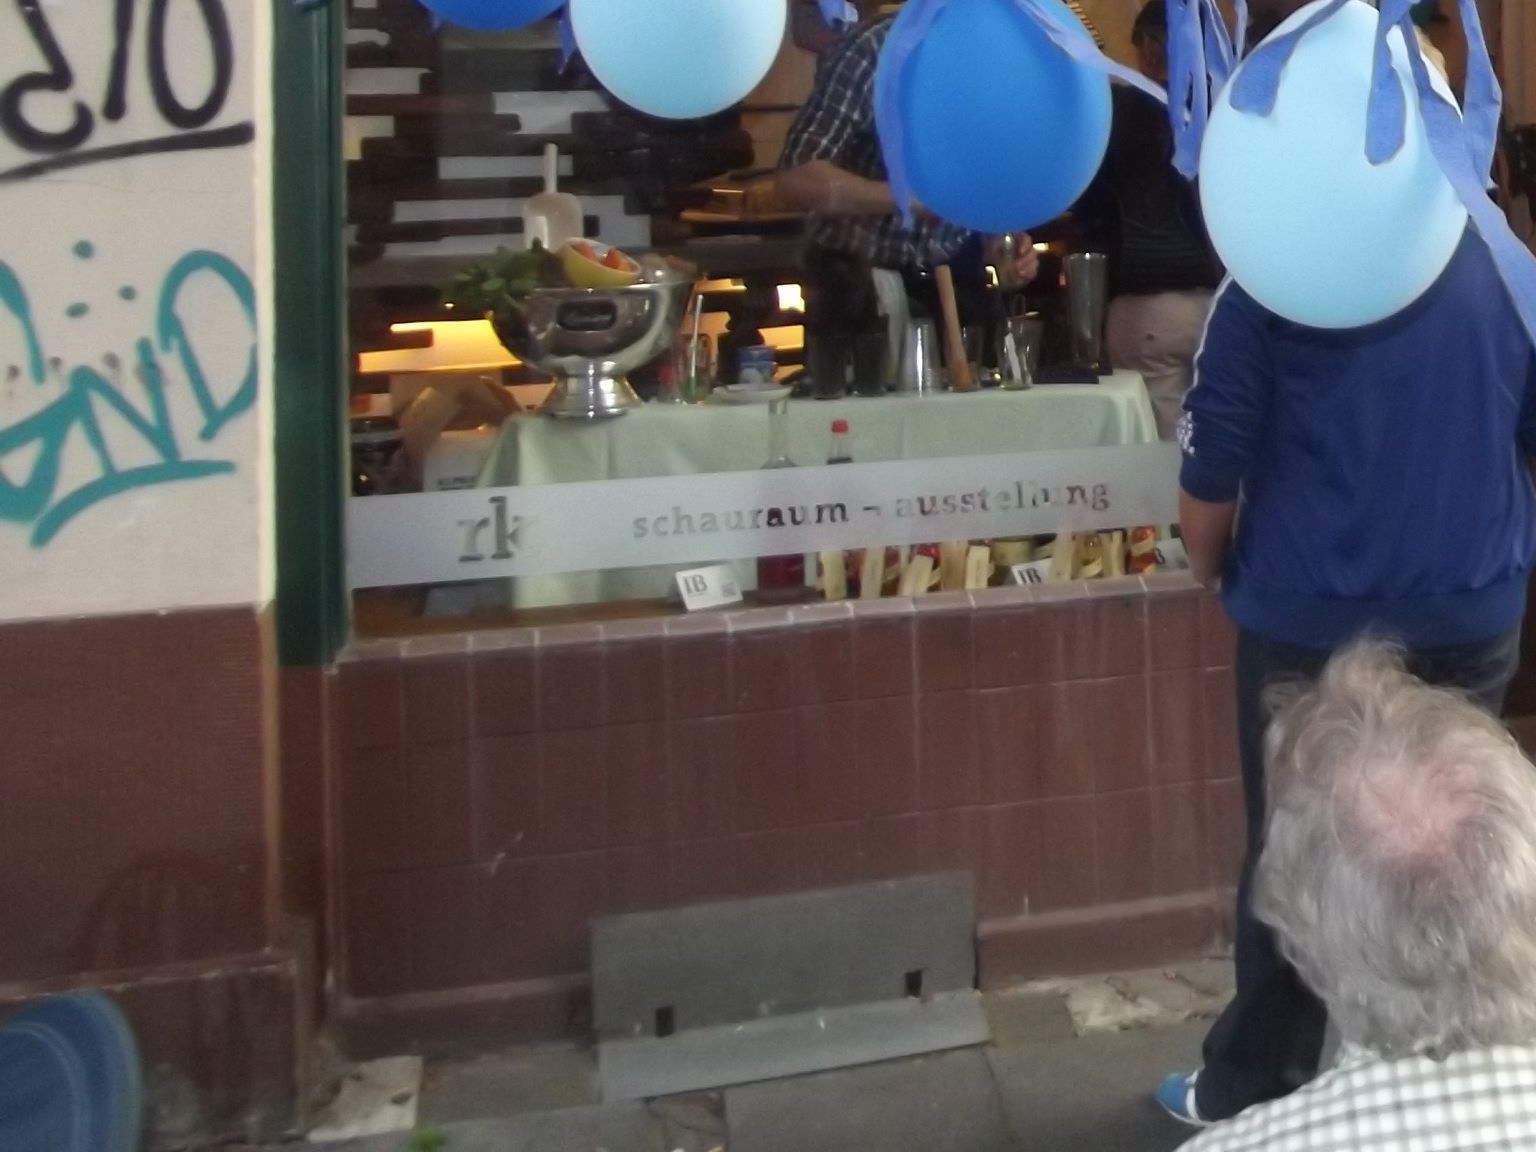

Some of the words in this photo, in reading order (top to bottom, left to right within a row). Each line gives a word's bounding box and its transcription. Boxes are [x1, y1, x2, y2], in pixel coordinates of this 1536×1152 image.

[456, 495, 532, 563] rk
[632, 500, 849, 540] schauraum
[895, 478, 1111, 518] ausstellung
